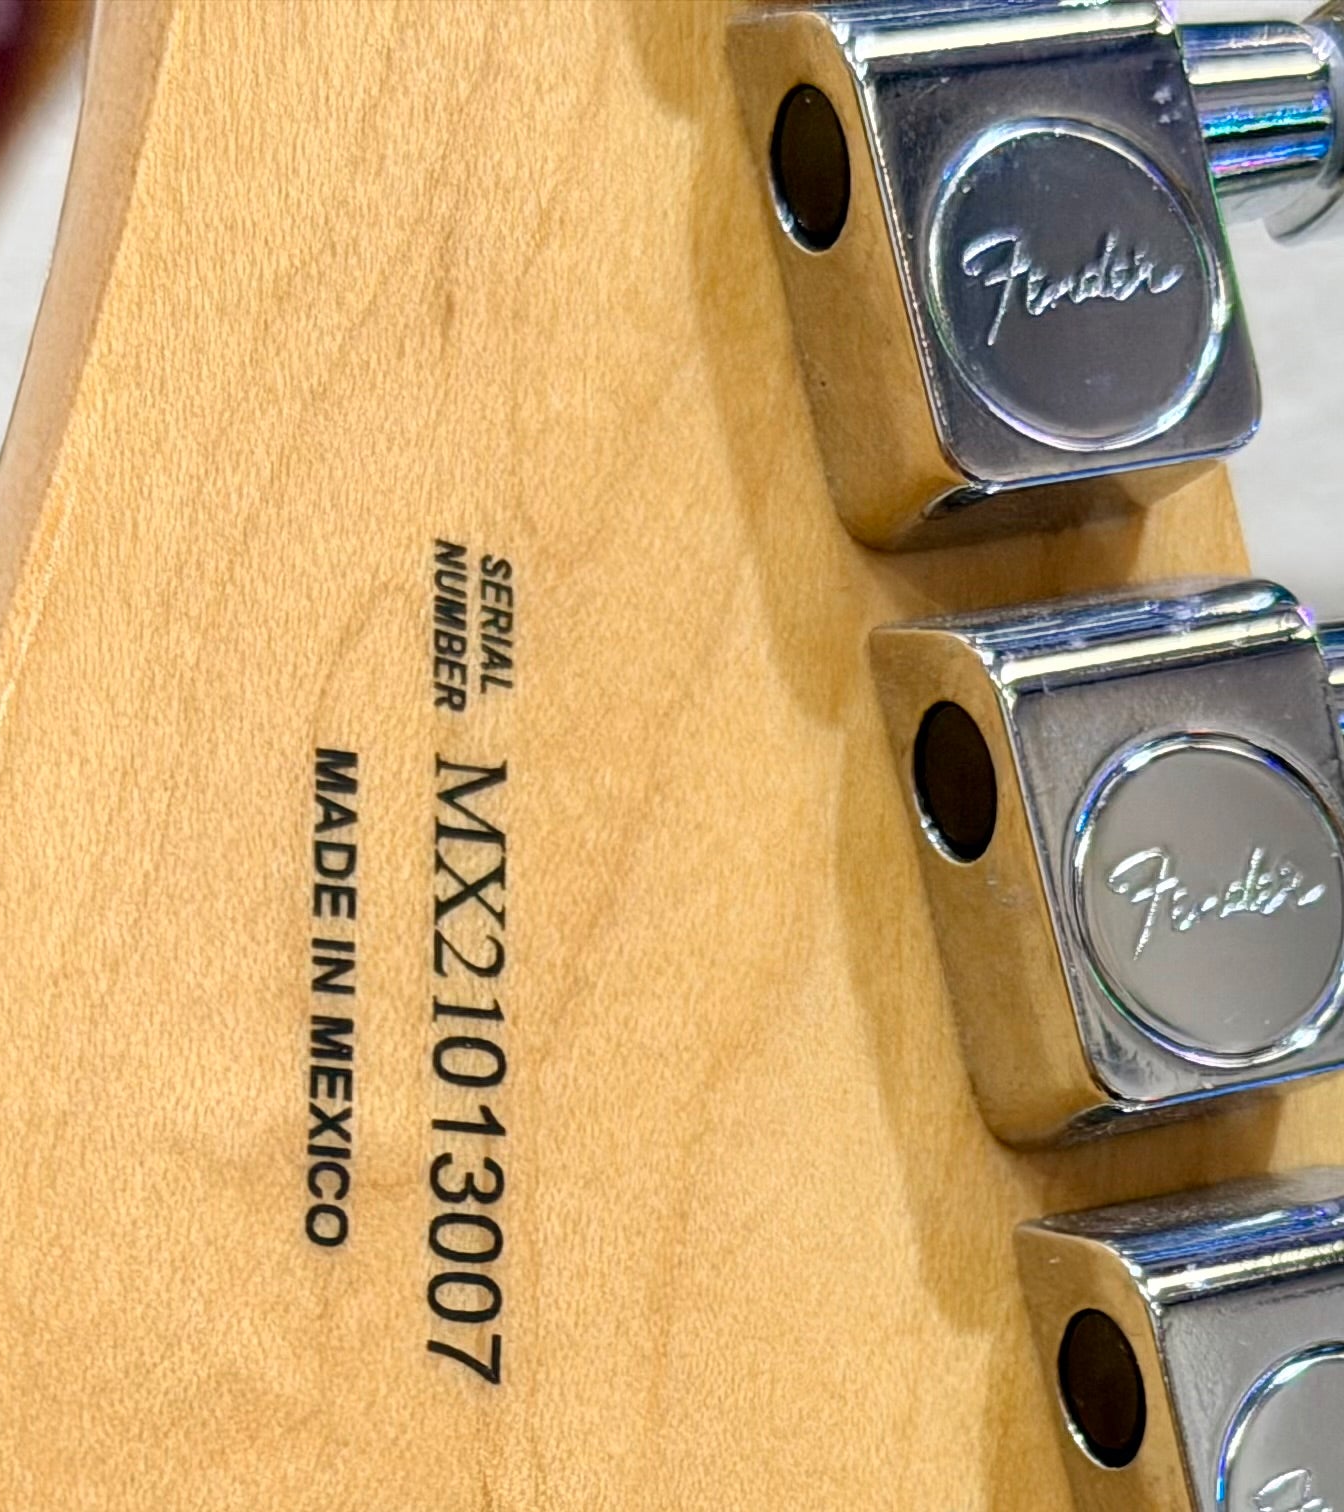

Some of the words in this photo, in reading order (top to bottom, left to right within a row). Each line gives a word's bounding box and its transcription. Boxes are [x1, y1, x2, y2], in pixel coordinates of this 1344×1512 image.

[961, 229, 1184, 347] Fender
[432, 537, 468, 713] NUMBER
[479, 553, 514, 694] SERIAL
[312, 747, 359, 920] MADE
[1108, 846, 1327, 962] Fender
[310, 937, 356, 995] IN
[304, 1014, 356, 1248] MEXICO
[426, 751, 508, 1387] MX21013007
